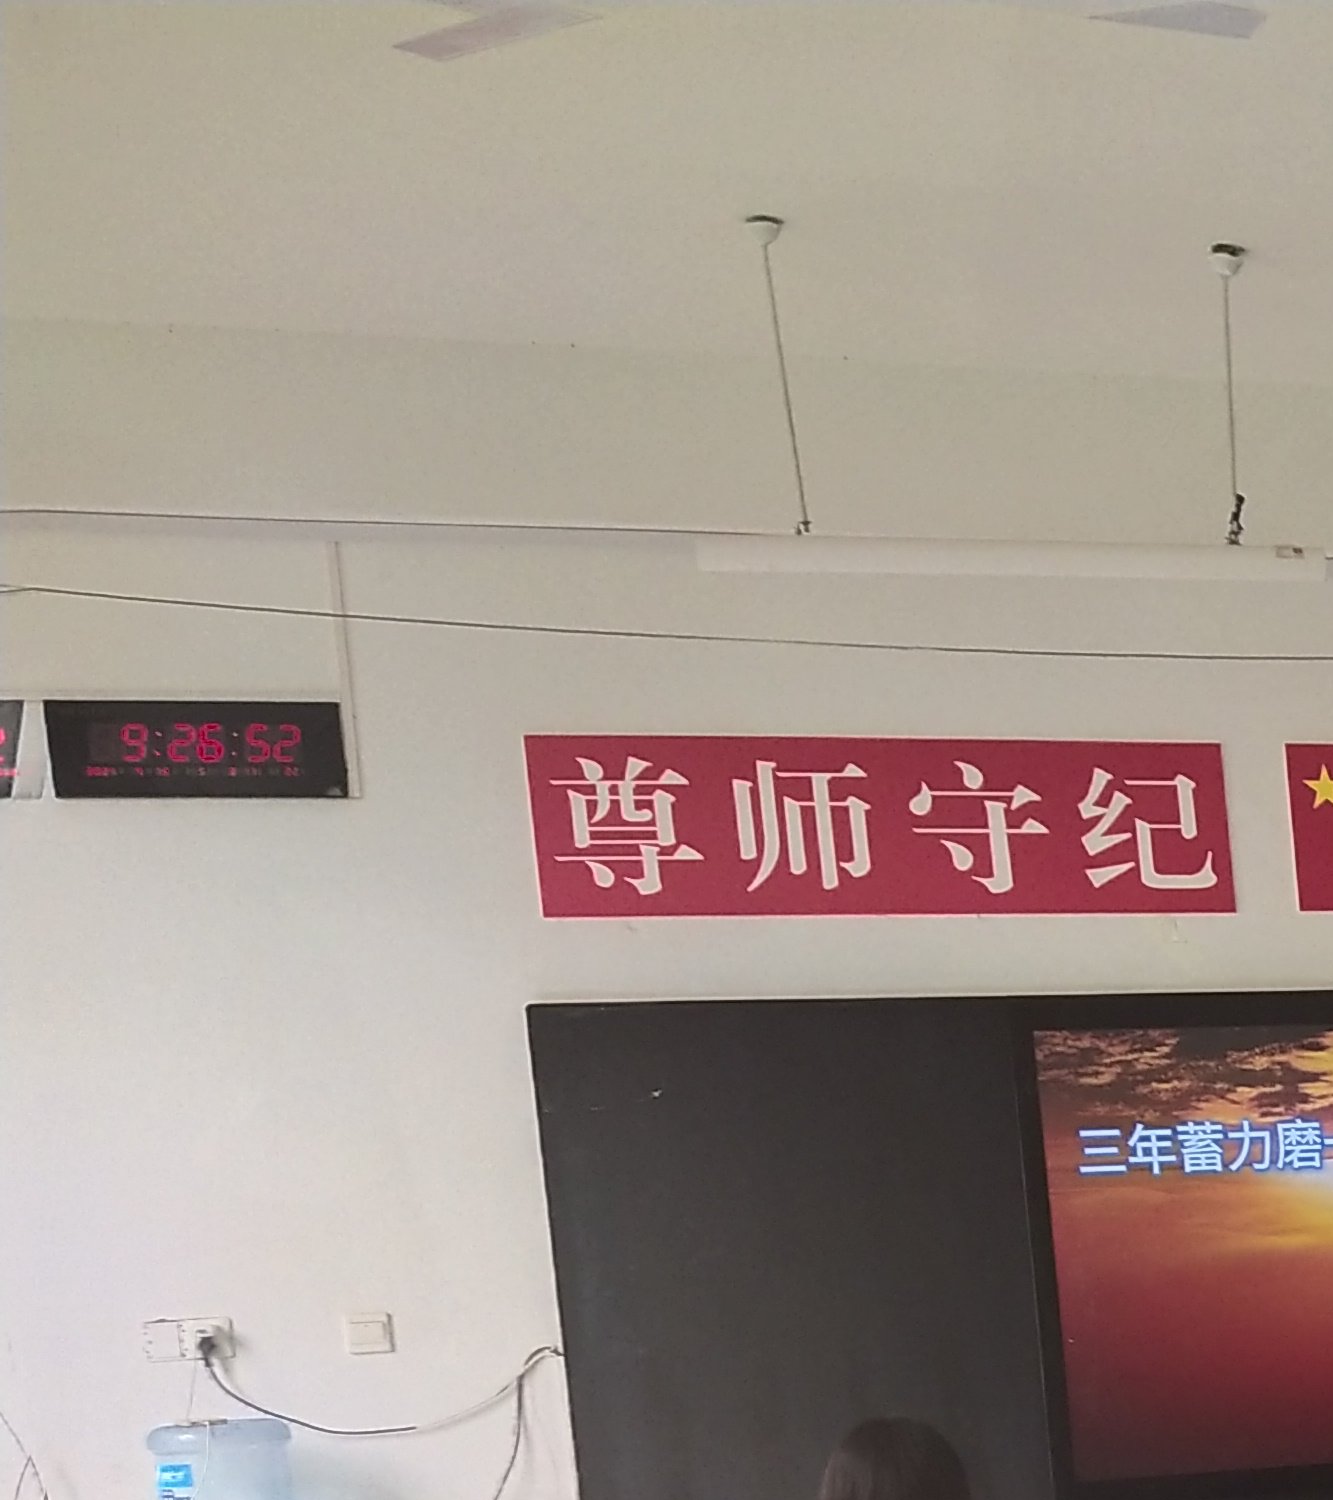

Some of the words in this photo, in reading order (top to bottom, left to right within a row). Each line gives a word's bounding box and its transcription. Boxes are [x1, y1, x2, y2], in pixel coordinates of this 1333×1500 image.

[119, 722, 302, 764] 9:26:52
[549, 756, 1219, 896] 尊师守纪
